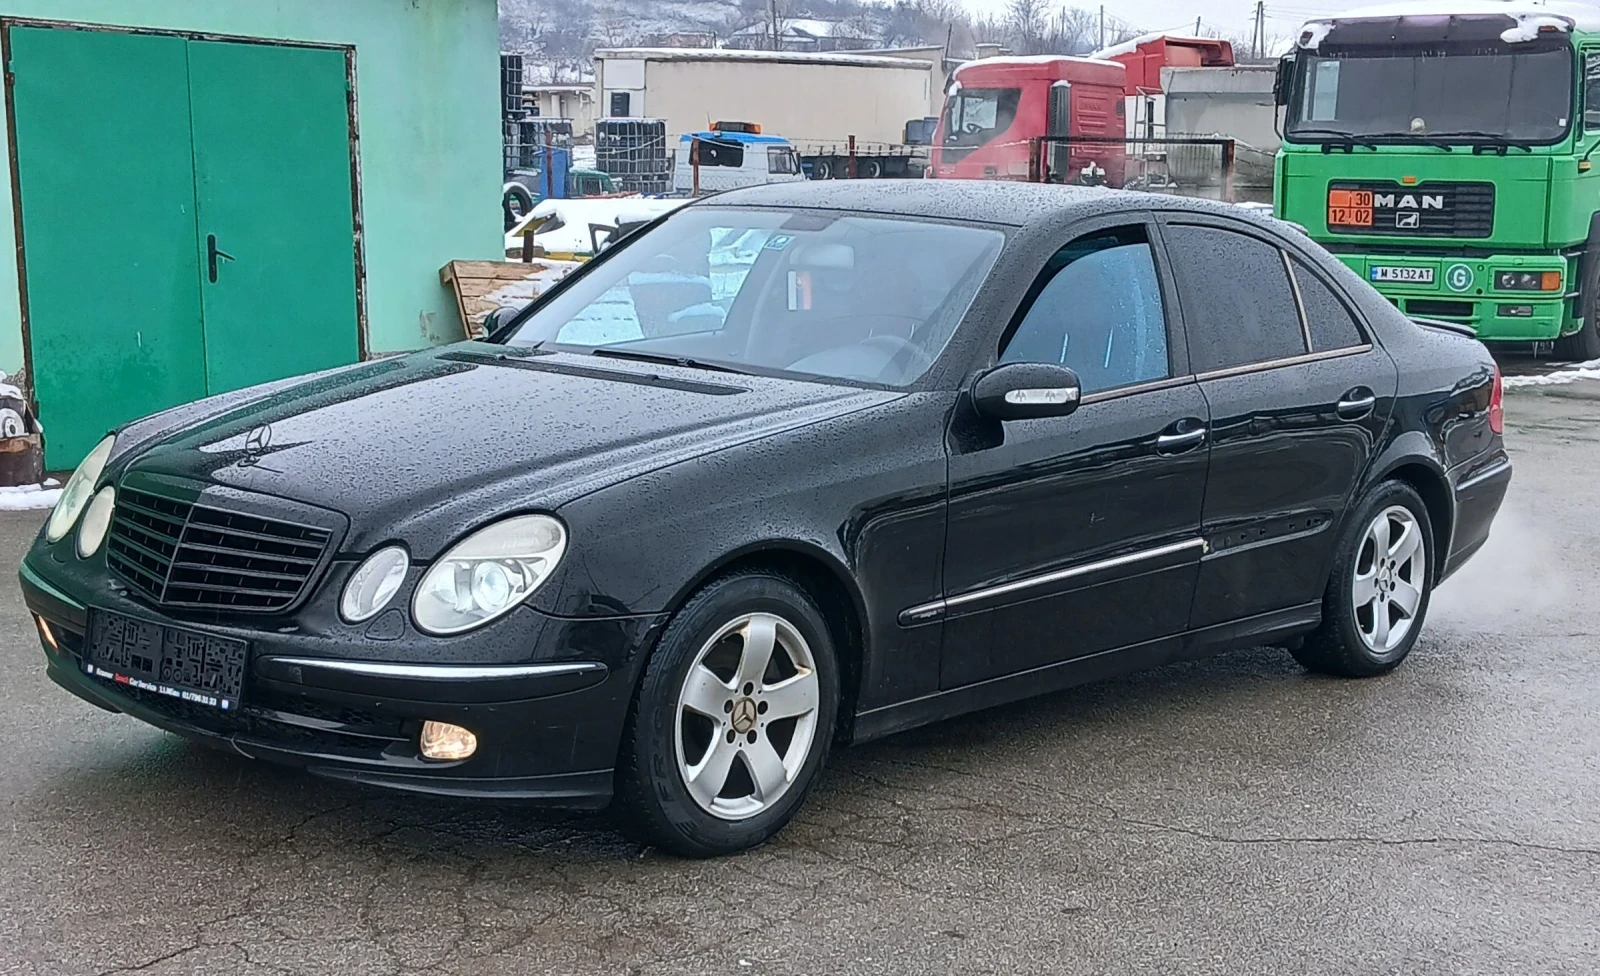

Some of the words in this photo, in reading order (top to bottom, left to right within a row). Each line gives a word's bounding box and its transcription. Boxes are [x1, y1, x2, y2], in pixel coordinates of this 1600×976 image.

[1355, 192, 1371, 206] 30
[1374, 194, 1444, 209] MAN
[1453, 269, 1466, 286] G
